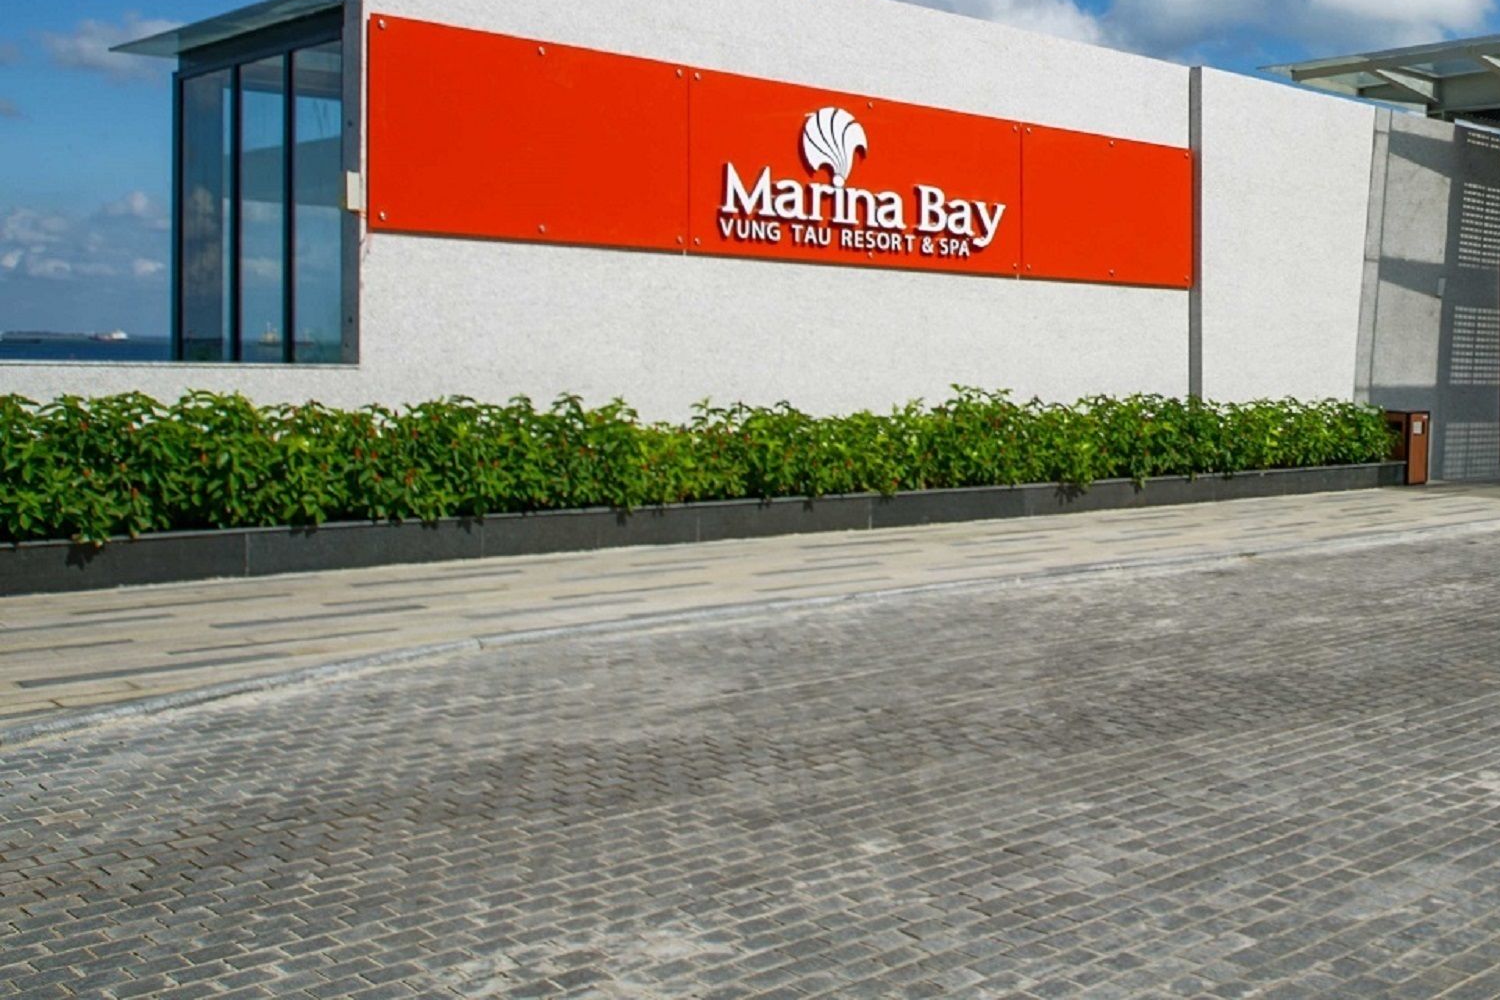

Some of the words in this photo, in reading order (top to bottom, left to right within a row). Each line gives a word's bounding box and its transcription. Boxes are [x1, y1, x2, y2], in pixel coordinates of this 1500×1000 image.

[720, 162, 906, 230] Marina
[914, 184, 1006, 248] Bay
[719, 217, 782, 242] VUNG
[791, 223, 832, 246] TAU
[841, 229, 915, 253] RESORT
[921, 237, 934, 255] &
[938, 238, 971, 257] SPA
